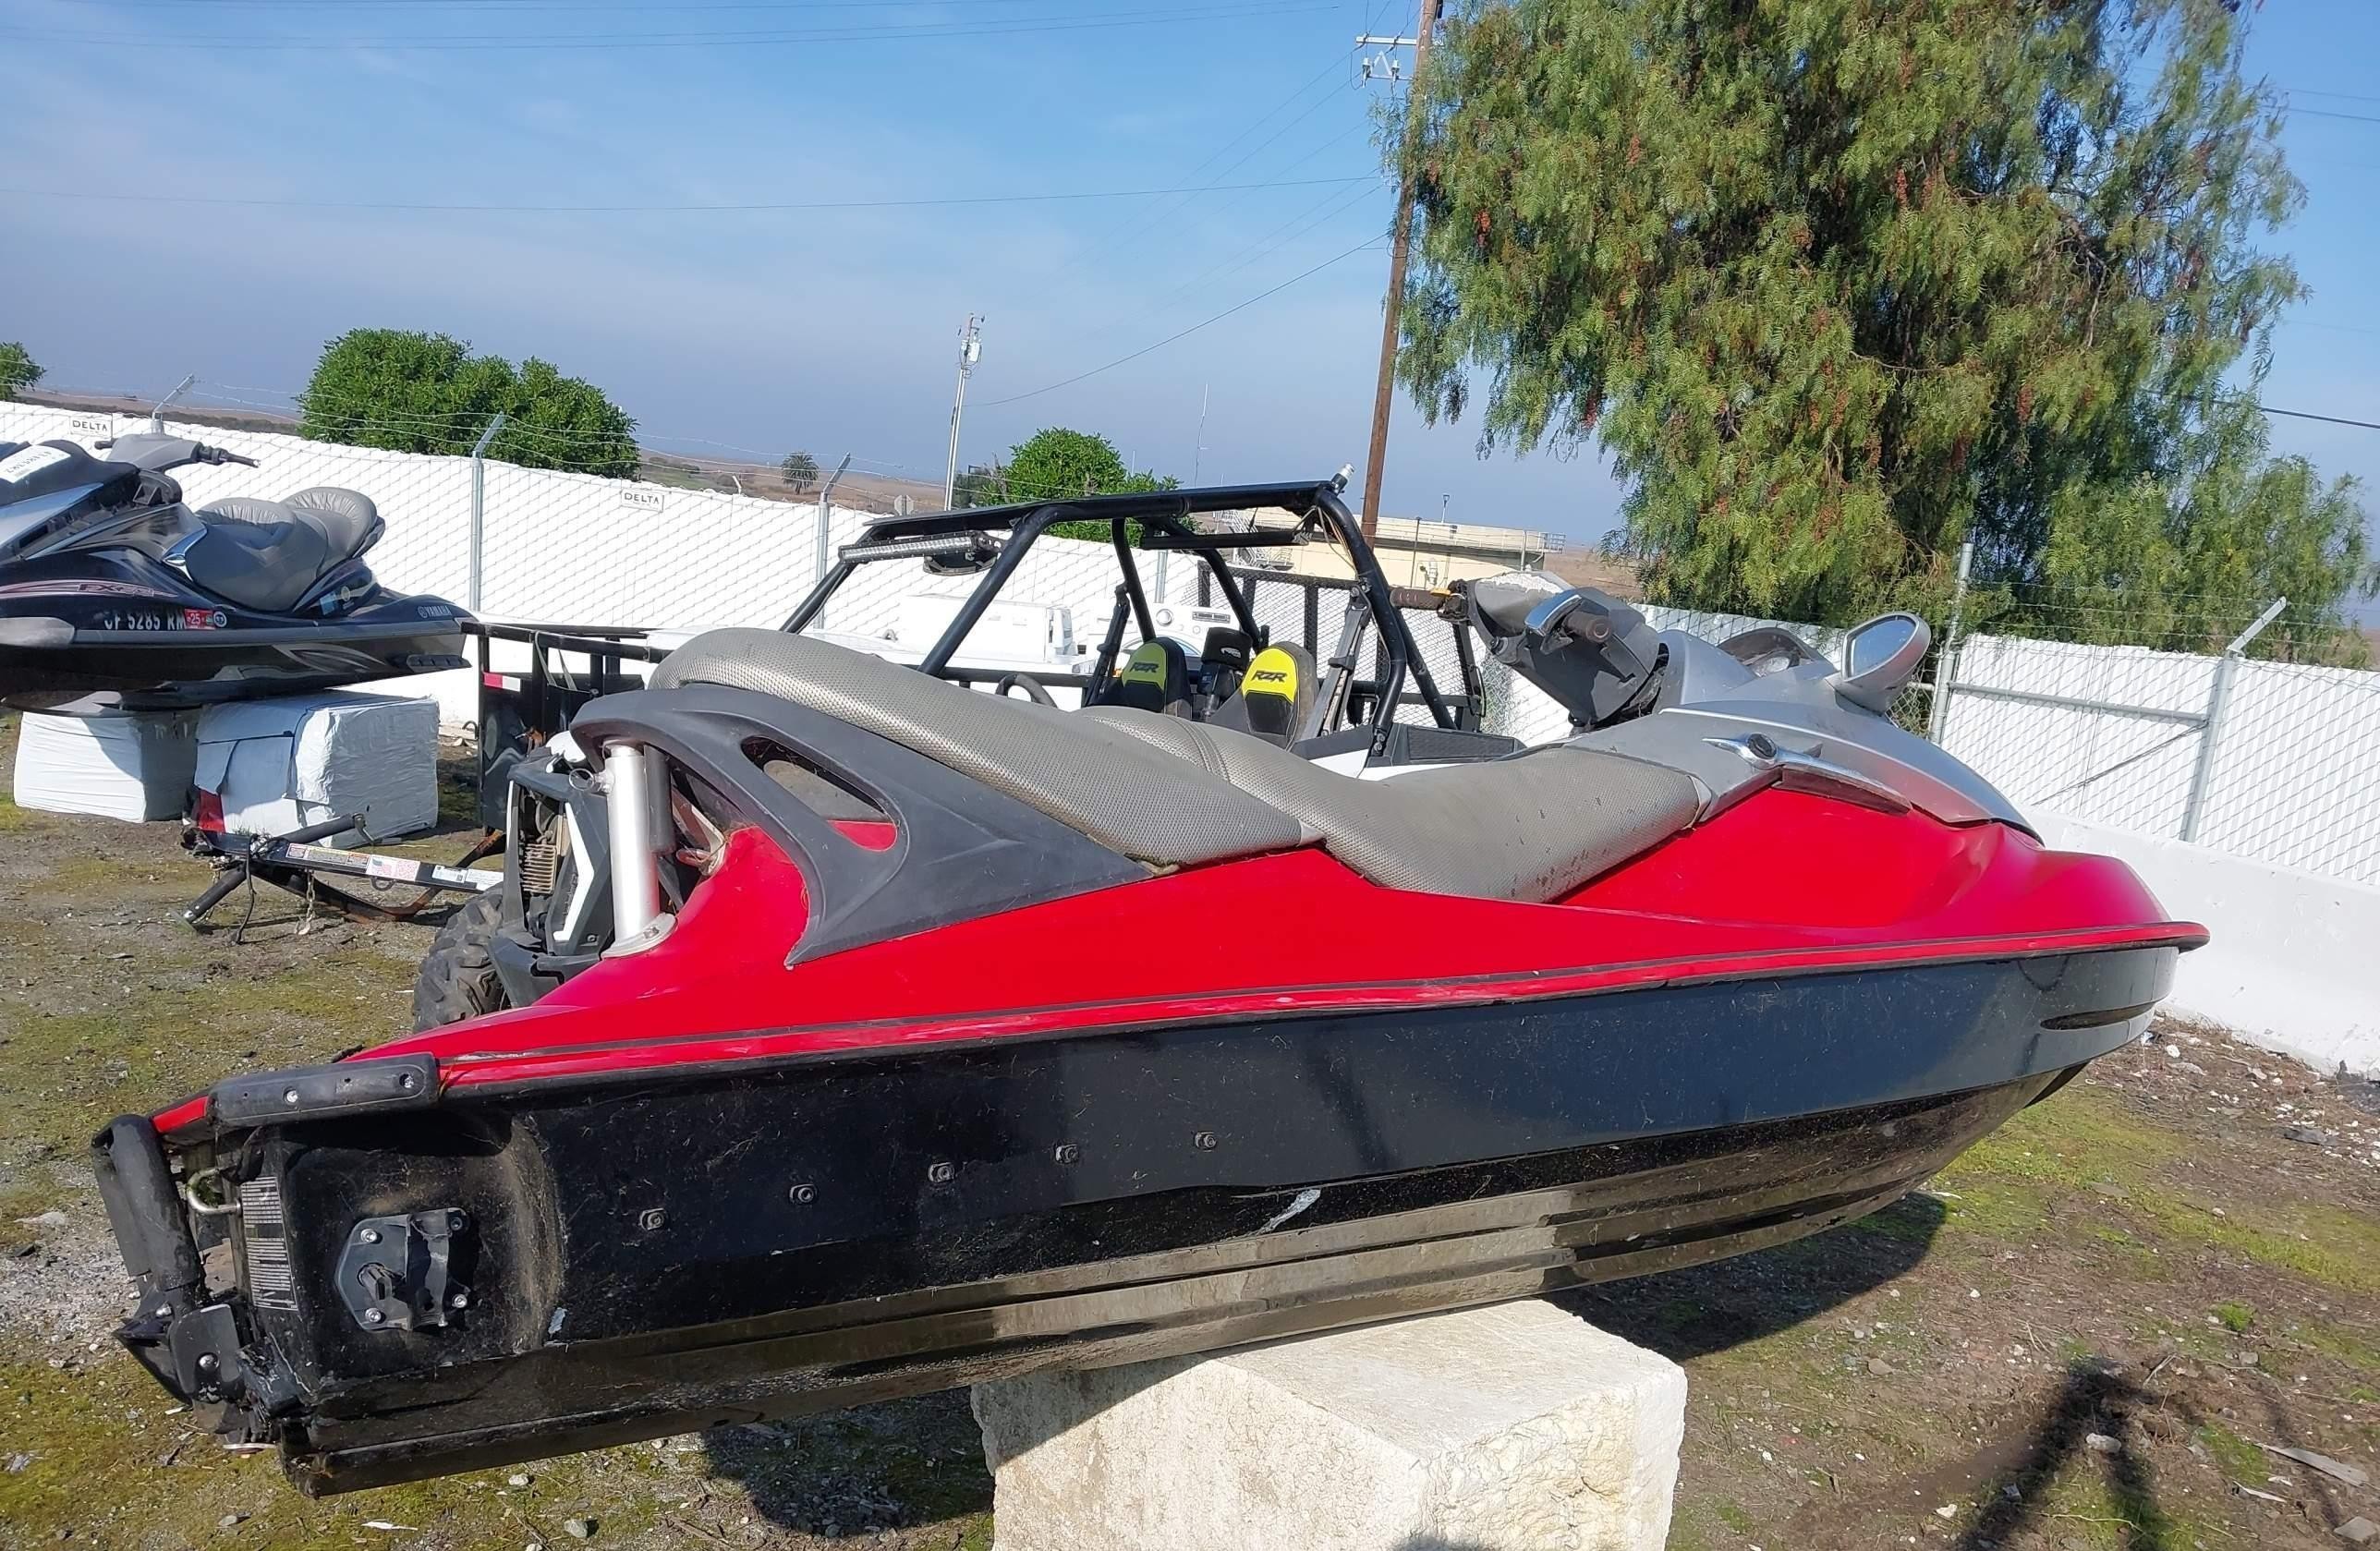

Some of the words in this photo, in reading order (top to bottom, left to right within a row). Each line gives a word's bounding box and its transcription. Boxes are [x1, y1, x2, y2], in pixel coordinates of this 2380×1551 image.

[72, 419, 108, 431] DELTA
[625, 492, 660, 504] DELTA
[127, 611, 161, 630] 5285
[190, 612, 201, 624] 25
[1129, 661, 1160, 673] RZR
[1251, 670, 1288, 683] RZR
